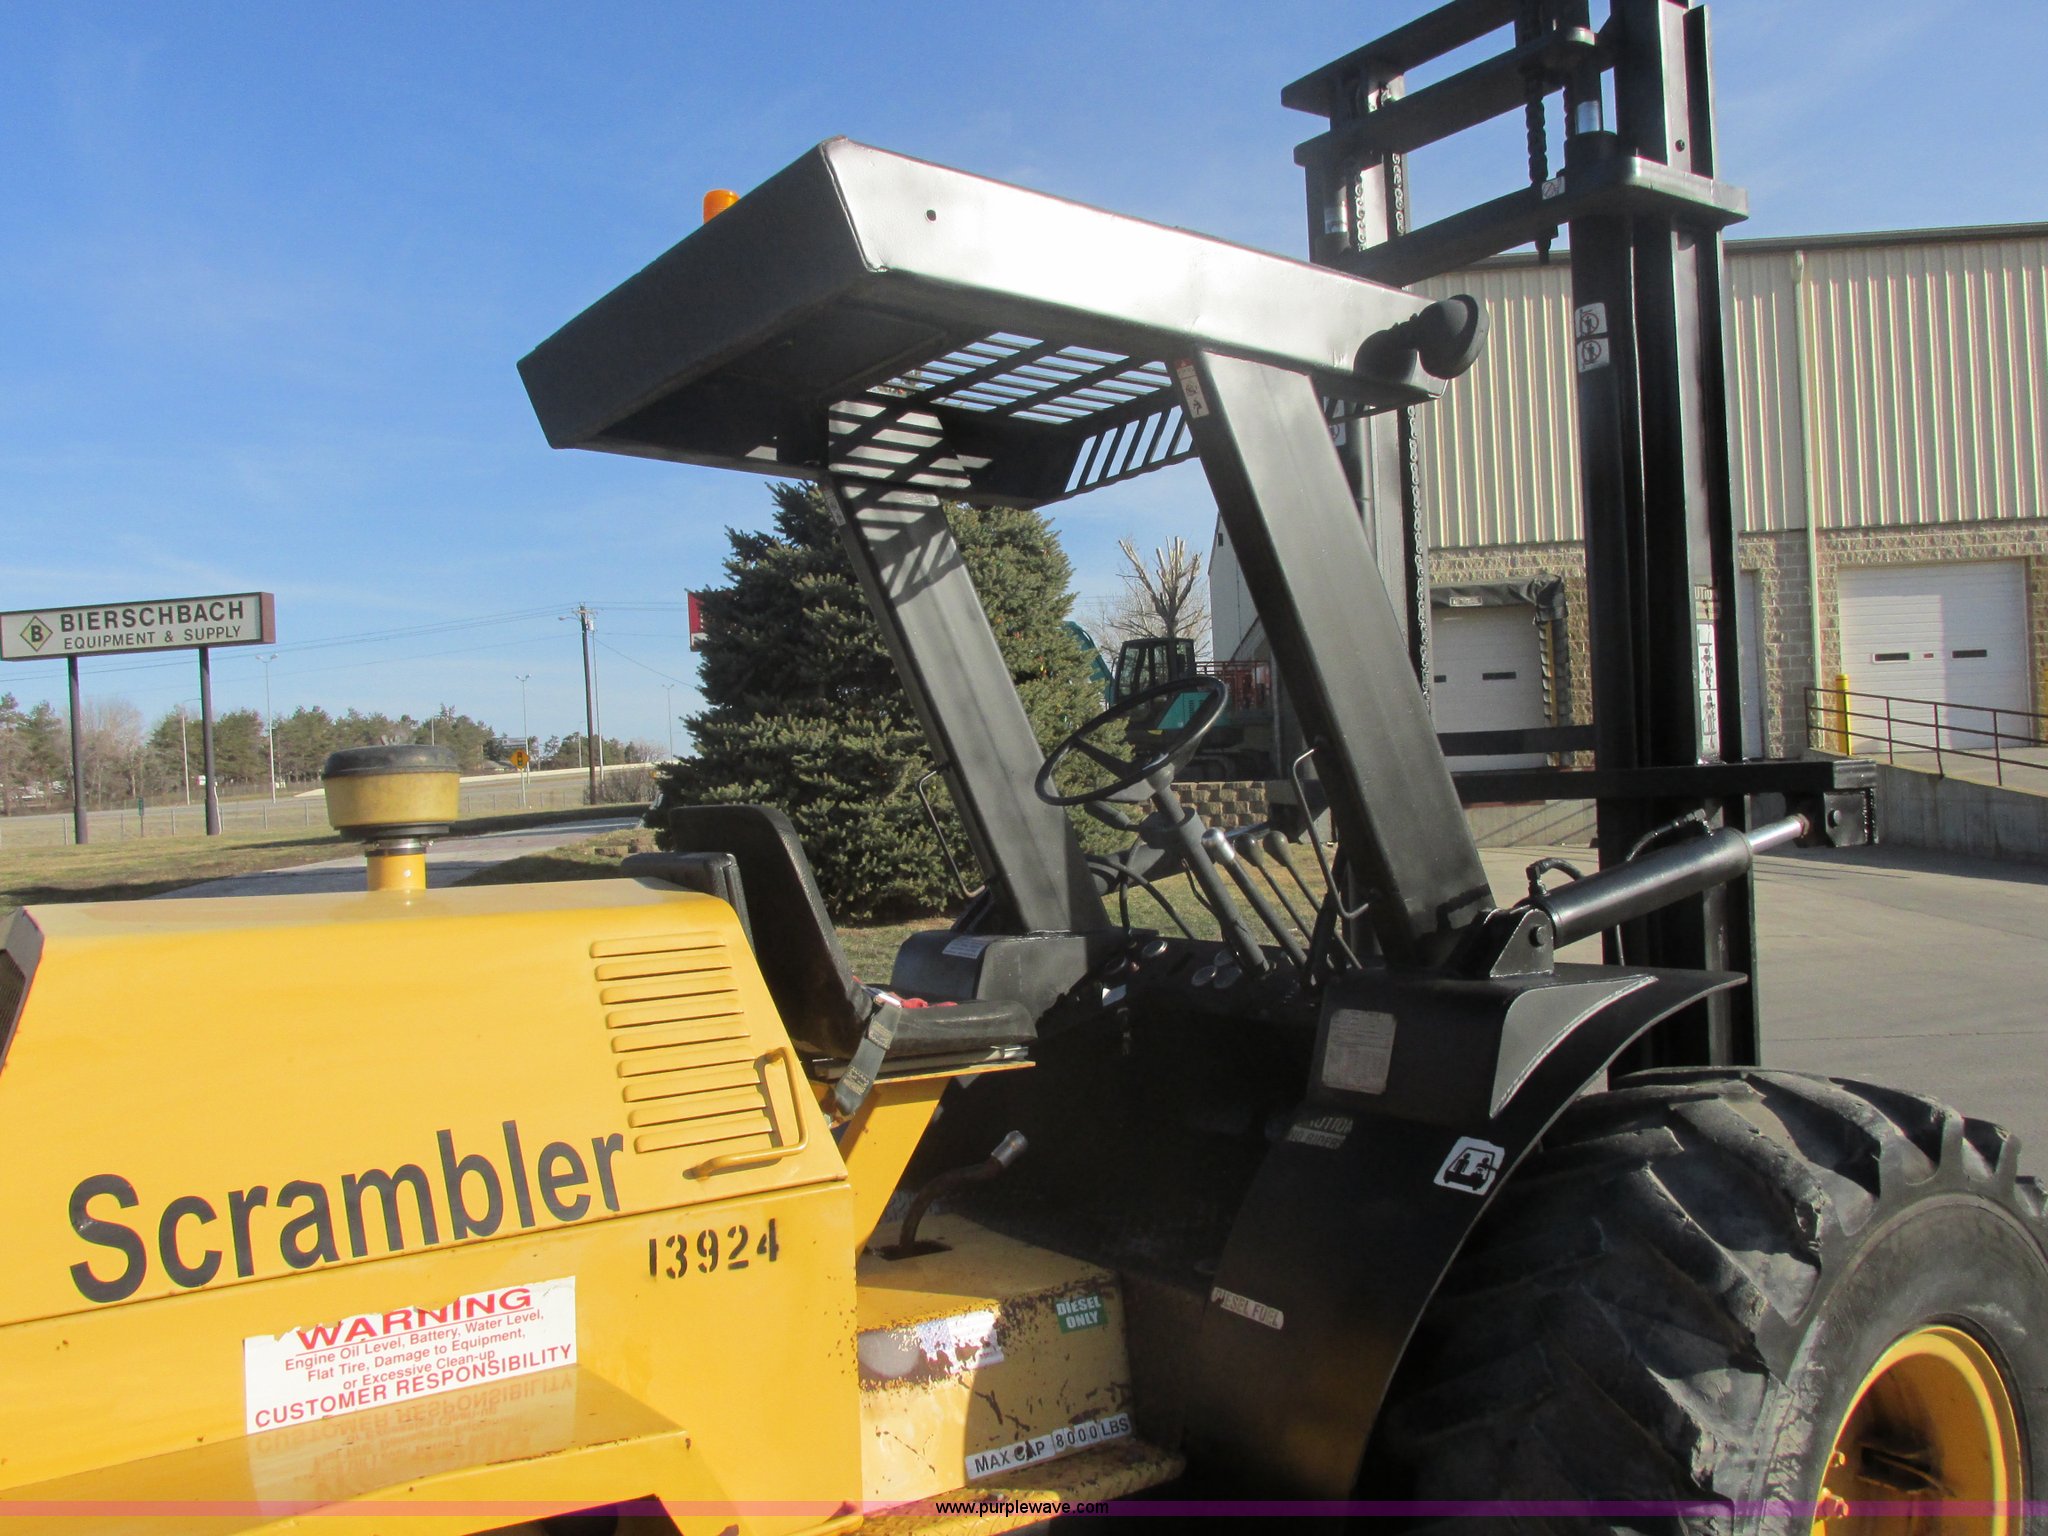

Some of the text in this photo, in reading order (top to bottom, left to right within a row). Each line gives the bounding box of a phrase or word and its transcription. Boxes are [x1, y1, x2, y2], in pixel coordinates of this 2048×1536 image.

[31, 625, 43, 642] B
[60, 600, 244, 632] BIERSCHBACH
[64, 625, 241, 650] EQUIPMENT & SUPPLY
[68, 1120, 624, 1303] Scrambler
[649, 1218, 779, 1279] 13924
[297, 1288, 531, 1350] WARNING
[1056, 1296, 1102, 1316] DIESEL
[1066, 1311, 1098, 1329] ONLY
[285, 1309, 544, 1371] Engine Oil Level, Battery, Water Level,
[308, 1328, 525, 1382] Flat Tire, Damage to Equipment,
[255, 1384, 387, 1428] CUSTOMER
[396, 1344, 571, 1396] RESPONSIBILITY
[343, 1350, 495, 1390] or Excessive Clean-up
[974, 1417, 1129, 1473] MAX CAP 8000 LBS
